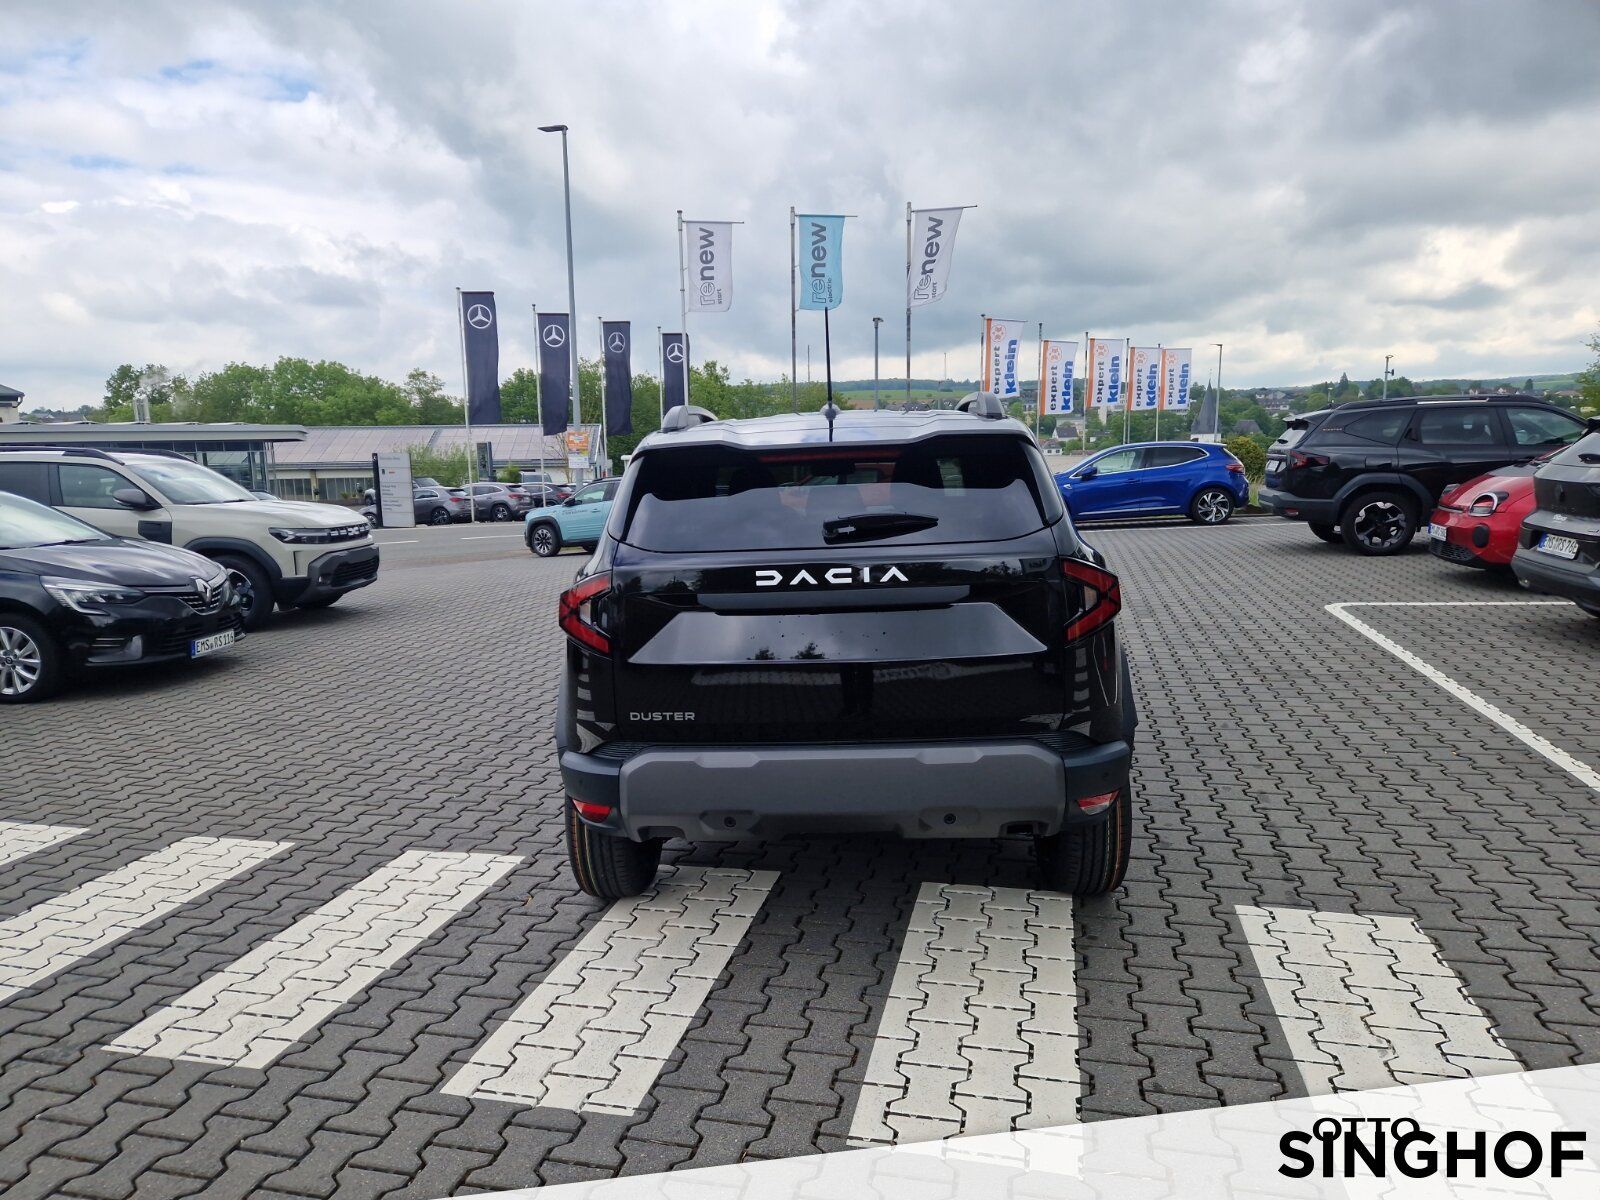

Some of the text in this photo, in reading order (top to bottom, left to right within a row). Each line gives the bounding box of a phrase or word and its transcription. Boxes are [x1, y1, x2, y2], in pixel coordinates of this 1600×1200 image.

[699, 227, 715, 305] renew
[811, 222, 827, 304] renew
[913, 216, 943, 300] renew
[993, 346, 1001, 394] expert
[1004, 339, 1018, 394] klein
[1050, 365, 1058, 410] expert
[1061, 360, 1074, 411] klein
[1096, 361, 1105, 403] expert
[1107, 355, 1120, 403] klein
[1146, 363, 1158, 407] klein
[1177, 363, 1189, 405] klein
[755, 566, 909, 586] DACIA
[196, 640, 210, 653] EMS
[629, 711, 696, 721] DUSTER
